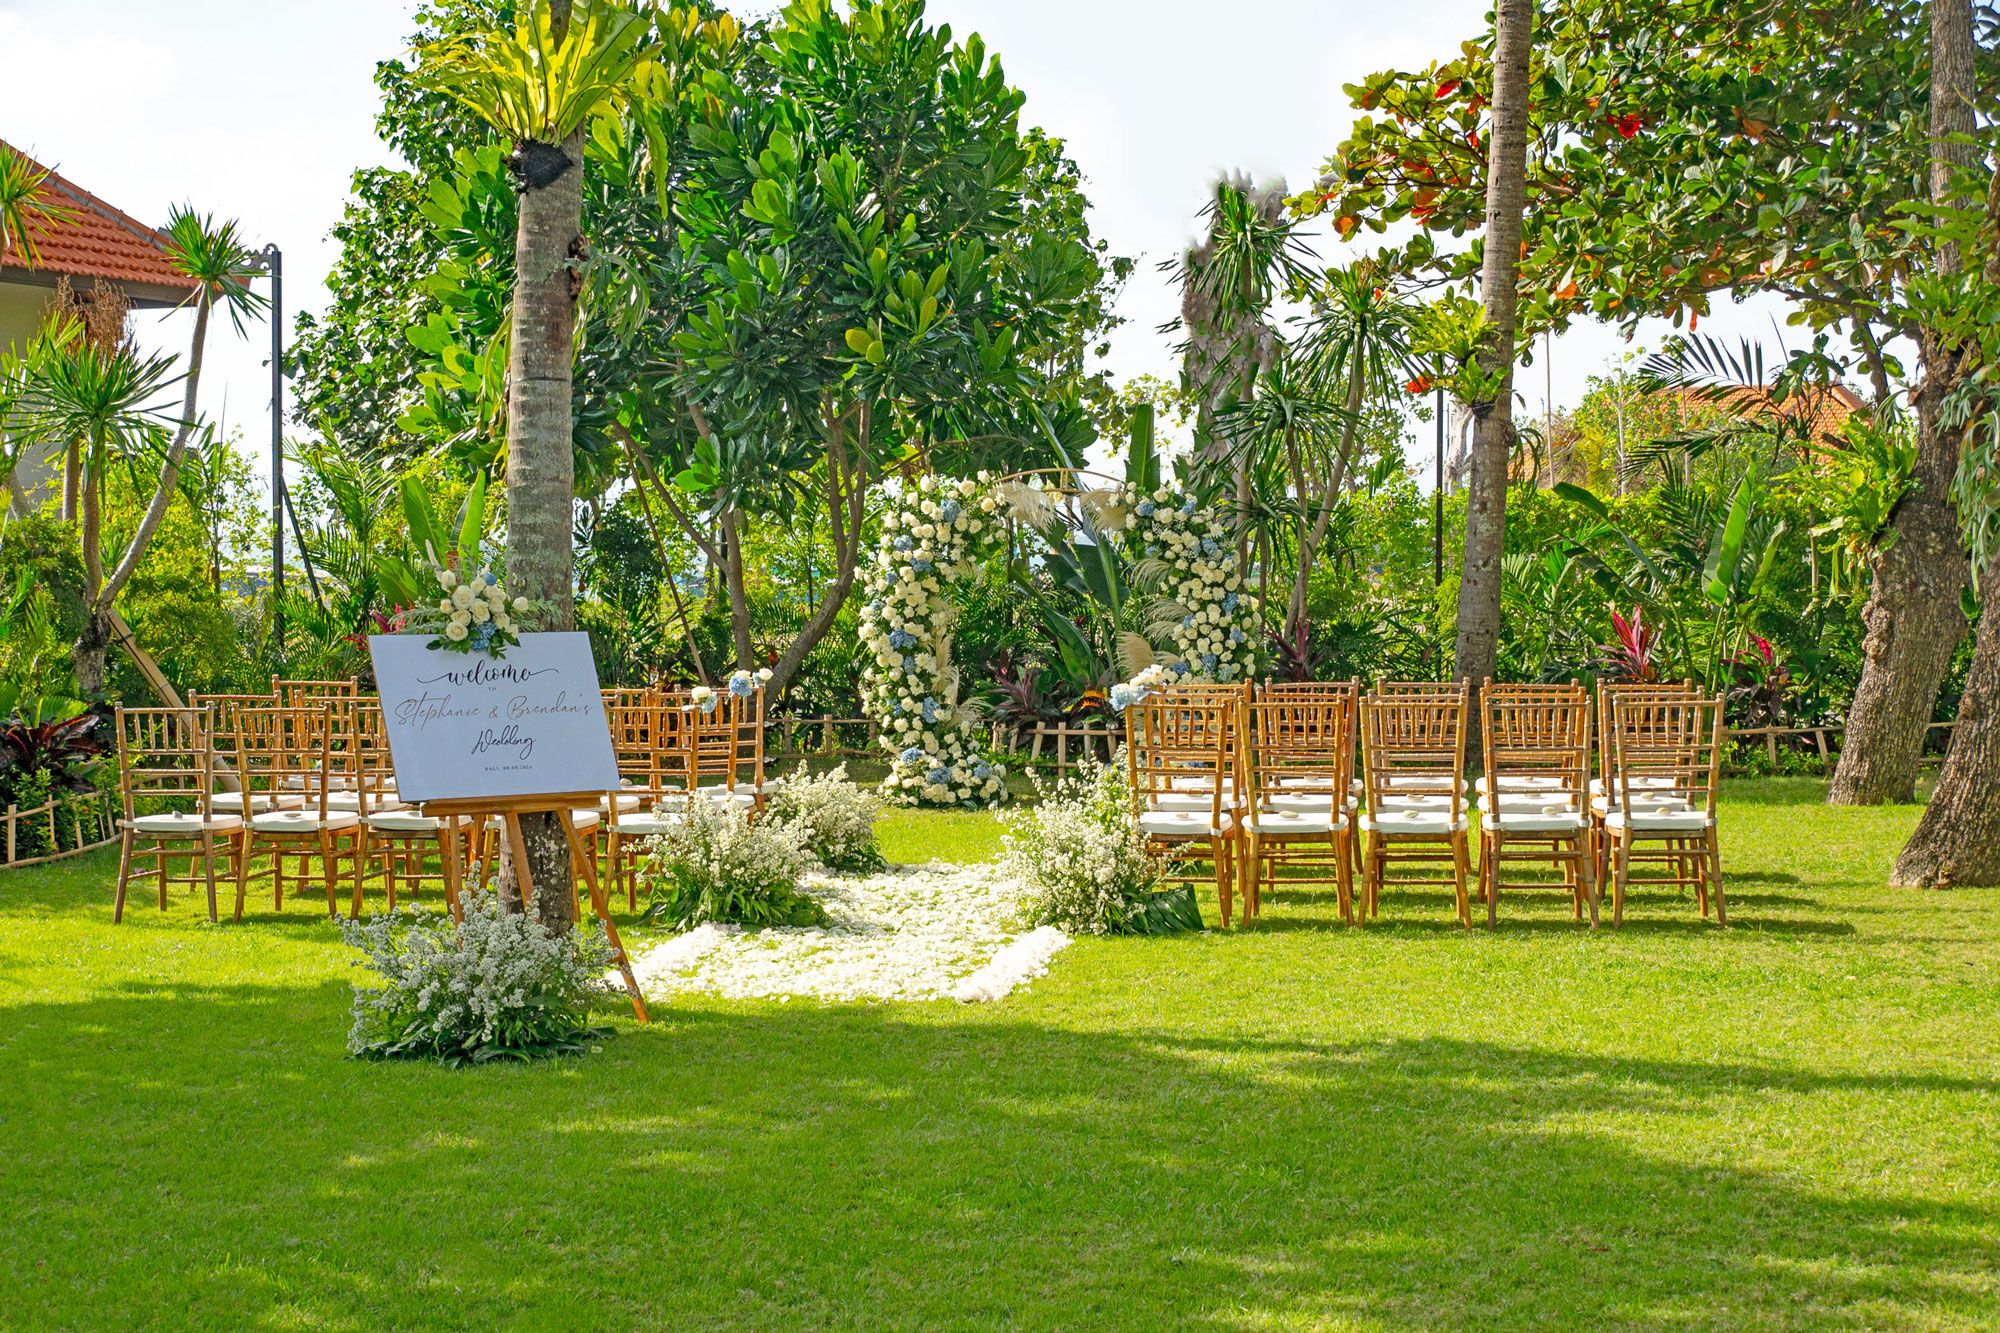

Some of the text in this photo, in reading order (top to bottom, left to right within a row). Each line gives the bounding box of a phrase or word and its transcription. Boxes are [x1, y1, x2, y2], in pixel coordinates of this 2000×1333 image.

[417, 660, 559, 686] welcome
[394, 691, 593, 730] Stephanie & Brendan's
[471, 725, 536, 760] Wedding
